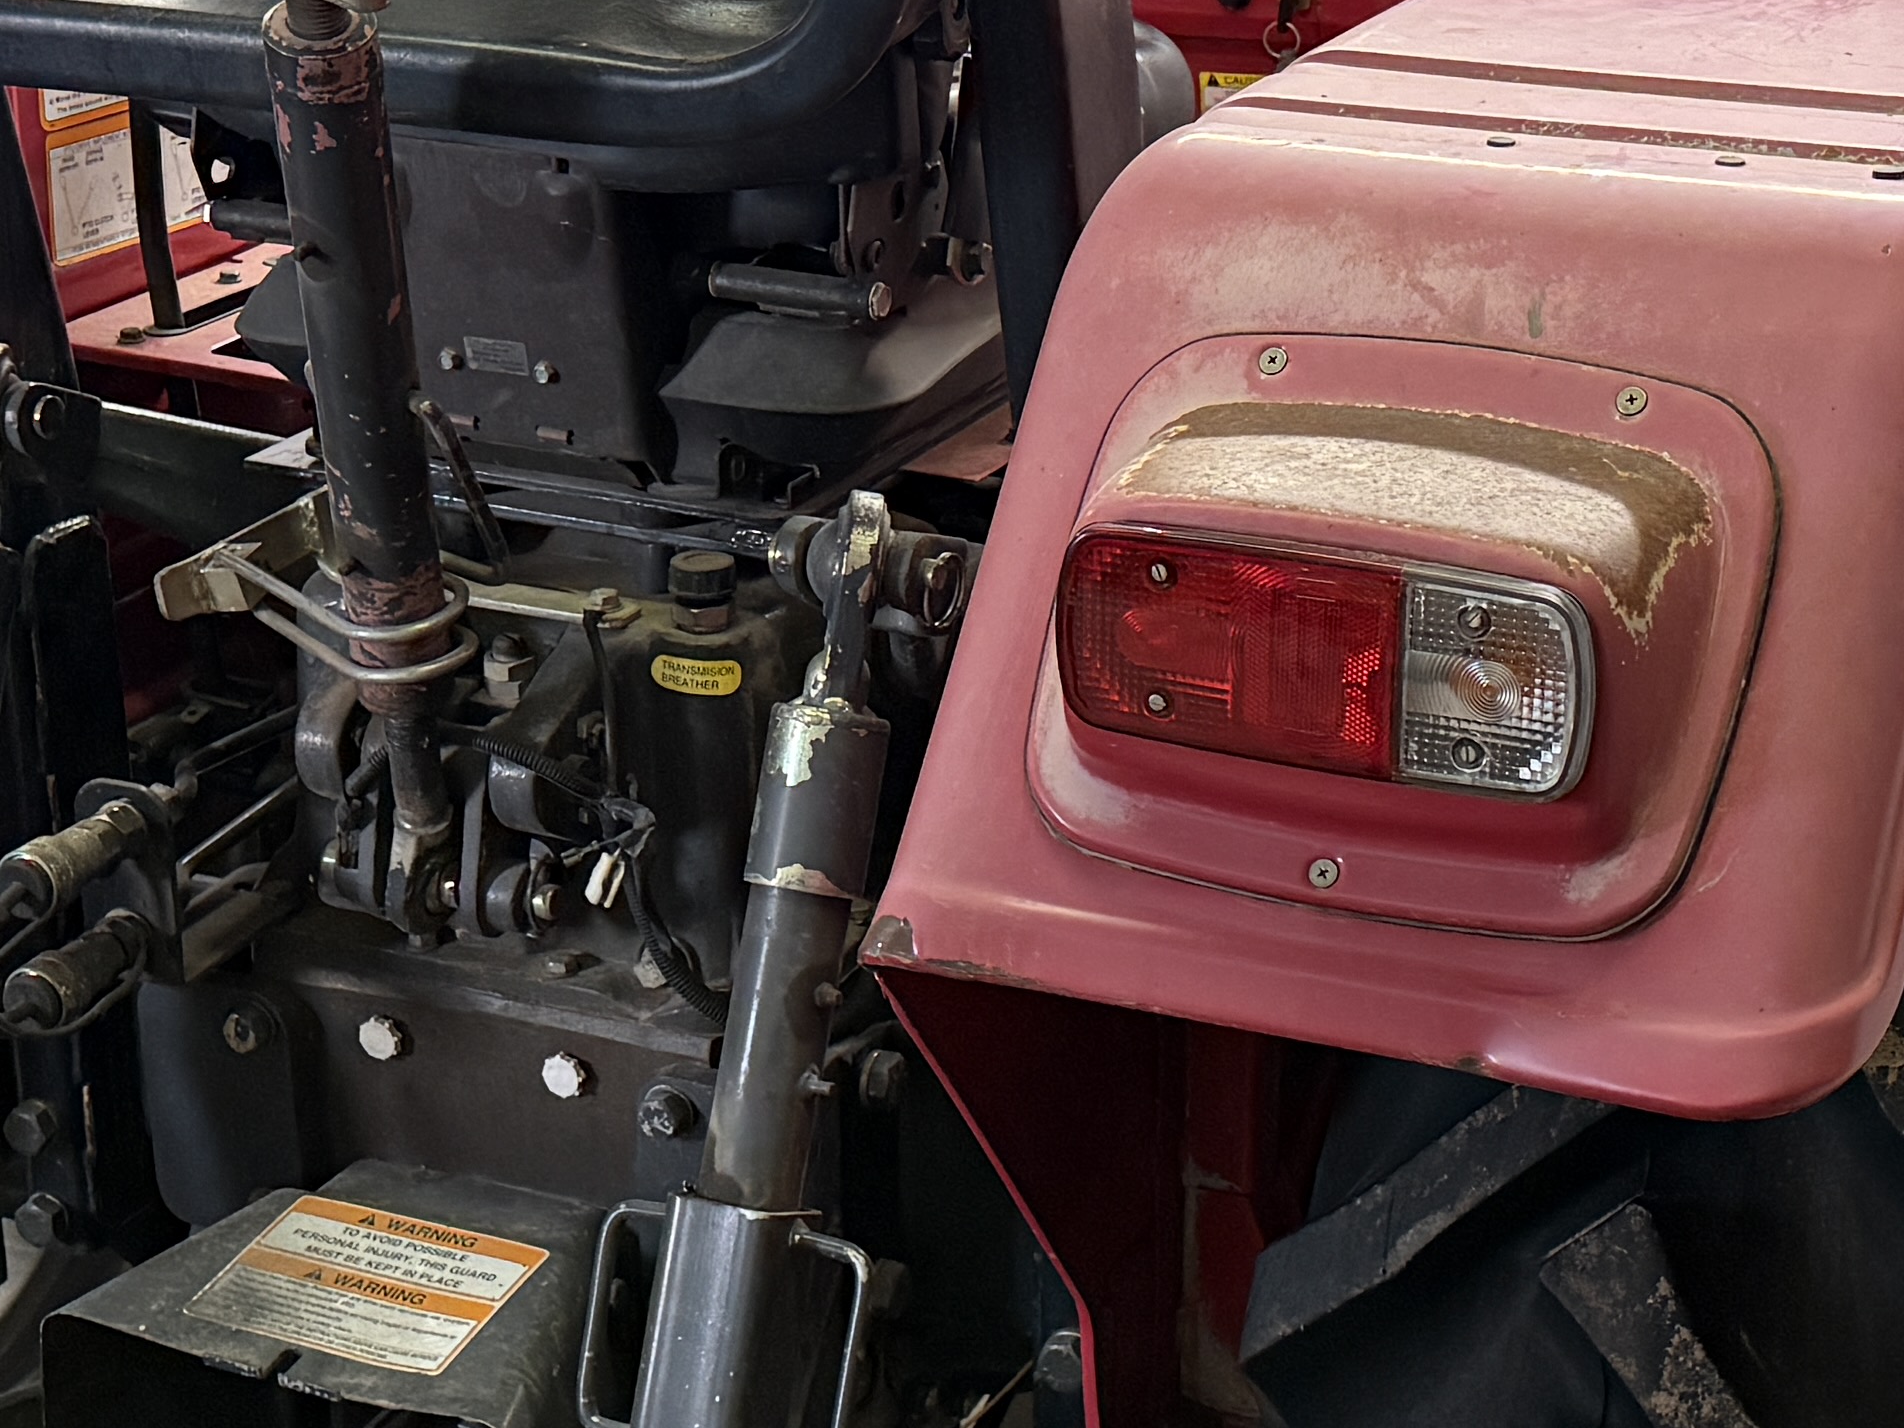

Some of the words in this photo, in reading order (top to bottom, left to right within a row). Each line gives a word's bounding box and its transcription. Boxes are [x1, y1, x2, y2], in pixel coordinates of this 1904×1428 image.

[661, 672, 720, 690] BREATHER
[342, 1226, 360, 1237] TO
[362, 1230, 404, 1248] AVOID
[405, 1241, 471, 1263] POSSIBLE
[387, 1218, 479, 1249] WARNING
[293, 1228, 361, 1252] PERSONAL
[418, 1258, 449, 1272] THIS
[449, 1265, 498, 1283] GUARD
[304, 1245, 343, 1260] MUST
[344, 1253, 364, 1266] BE
[365, 1258, 400, 1274] KEPT
[400, 1267, 418, 1278] IN
[418, 1272, 465, 1289] PLACE
[332, 1272, 428, 1306] WARNING
